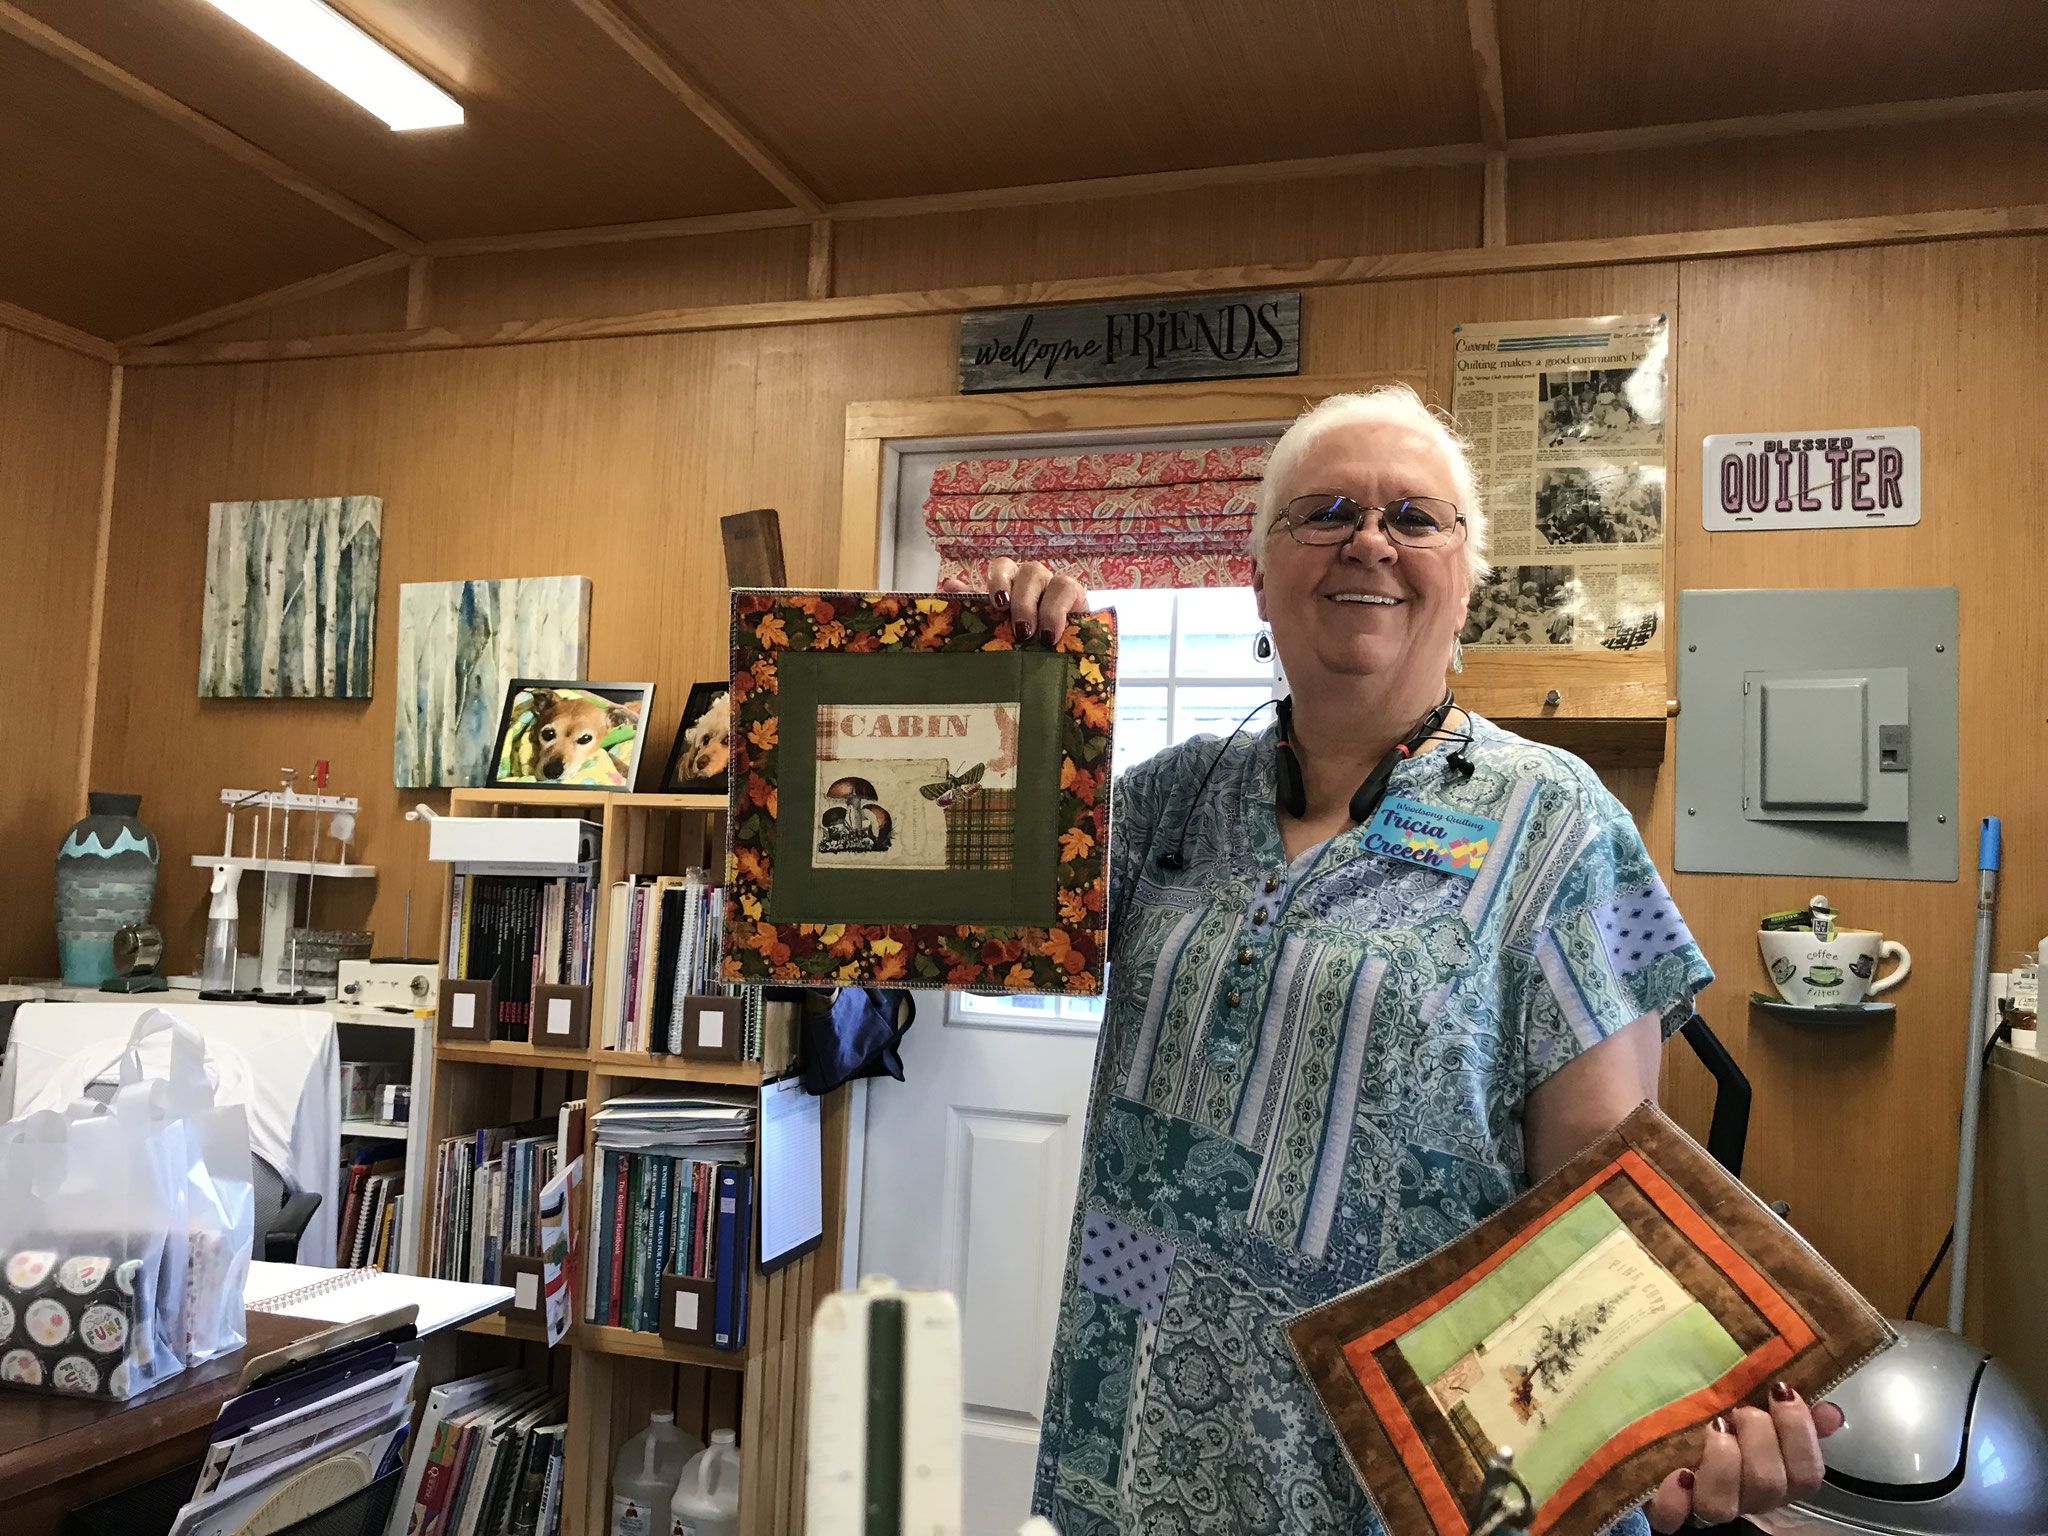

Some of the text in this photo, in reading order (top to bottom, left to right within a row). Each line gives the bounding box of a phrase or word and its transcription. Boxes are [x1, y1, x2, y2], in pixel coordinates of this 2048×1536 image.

[975, 315, 1102, 379] welcome
[1457, 359, 1497, 371] Quilting
[1500, 358, 1531, 367] makes
[1545, 355, 1570, 367] good
[1572, 354, 1628, 365] community
[1764, 437, 1853, 452] BLESSED
[1721, 447, 1902, 513] QUILTER
[840, 714, 971, 737] CABIN
[1381, 809, 1447, 839] Tricia
[1397, 803, 1485, 831] Woodsong Quilting
[1365, 833, 1442, 866] Creech
[453, 884, 461, 917] SINGER
[1806, 949, 1839, 960] coffee
[660, 1165, 668, 1199] BONESTEEL
[616, 1194, 624, 1222] Quilter's
[614, 1223, 623, 1255] Handbook
[657, 1226, 665, 1244] IDEAS
[653, 1271, 661, 1299] QUILTING
[86, 1317, 122, 1344] FUN!
[541, 1457, 554, 1514] UPHOLSTERY
